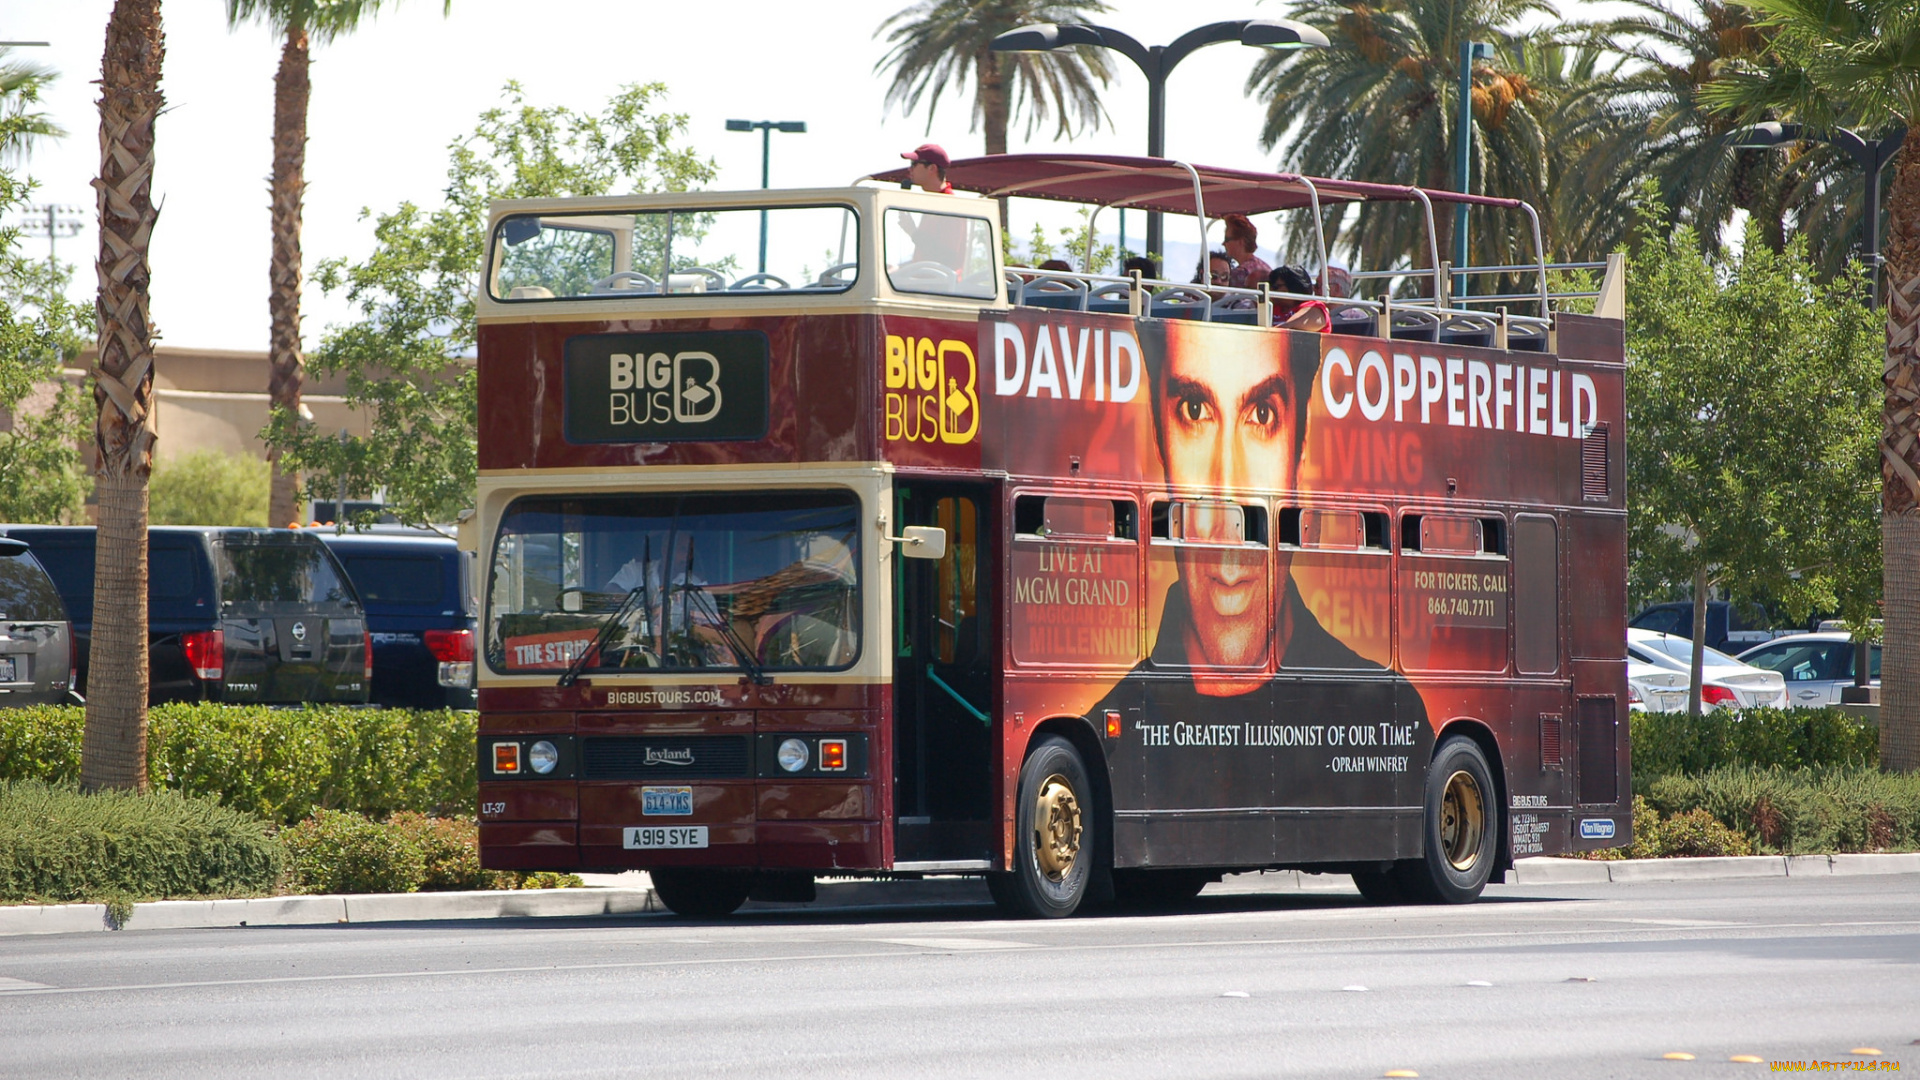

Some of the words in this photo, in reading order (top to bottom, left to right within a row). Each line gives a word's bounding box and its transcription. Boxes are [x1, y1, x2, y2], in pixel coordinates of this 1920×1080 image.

[610, 352, 671, 390] BIG
[885, 335, 937, 391] BIG
[994, 321, 1141, 404] DAVID
[1321, 346, 1598, 440] COPPERFIELD
[610, 391, 672, 425] BUS
[885, 392, 938, 443] BUS
[1039, 545, 1077, 573] LIVE
[1082, 546, 1105, 574] AT
[1014, 577, 1061, 604] MGM
[1065, 577, 1129, 606] GRAND
[1415, 571, 1435, 589] FOR
[1437, 572, 1481, 592] TICKETS,
[1483, 575, 1507, 593] CALL
[1428, 598, 1494, 617] 866.740.7711
[514, 644, 542, 666] THE
[545, 639, 590, 663] STRIP
[227, 683, 258, 692] TITAN
[608, 690, 721, 705] BIGBUSTOURS.COM
[1327, 725, 1345, 747] OF
[1348, 725, 1378, 747] OUR
[643, 747, 694, 766] Leyland
[1367, 756, 1409, 773] WINFREY
[482, 802, 506, 814] LT-37
[633, 829, 665, 846] A919
[669, 829, 698, 845] SYE
